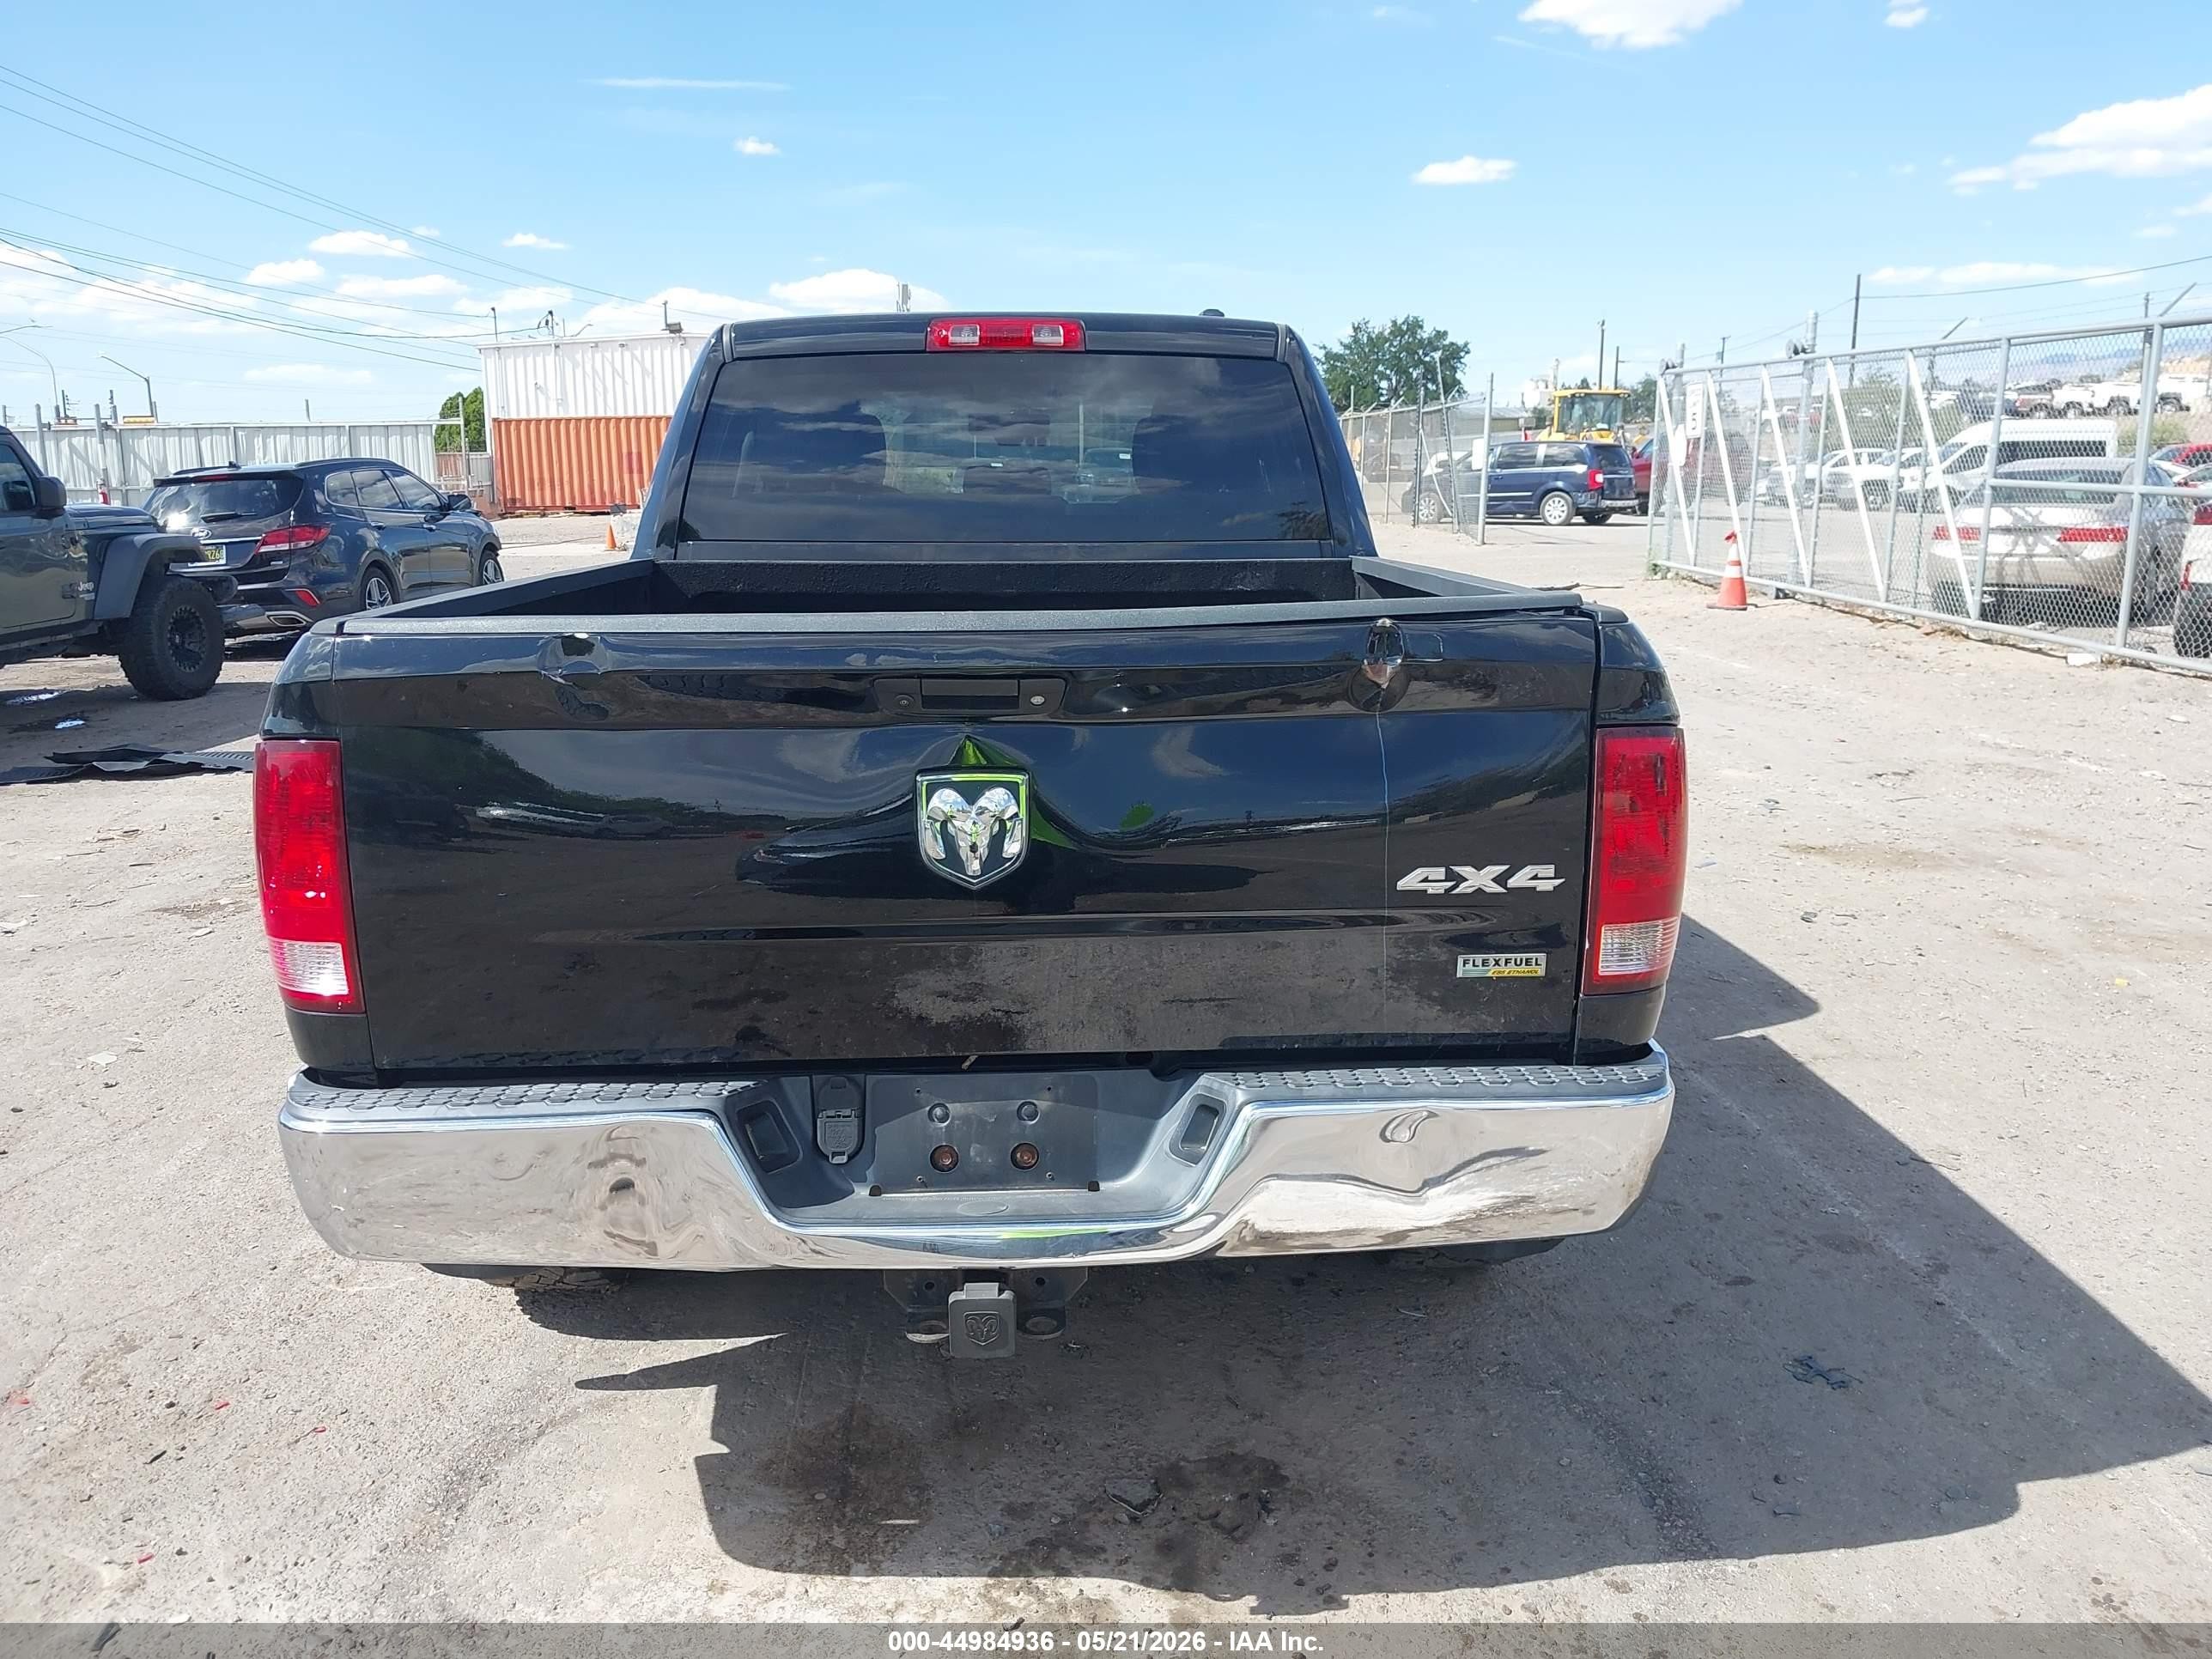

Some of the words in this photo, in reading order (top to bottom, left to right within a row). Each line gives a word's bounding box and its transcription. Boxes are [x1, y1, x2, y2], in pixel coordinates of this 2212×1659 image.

[1691, 412, 1698, 430] 5
[78, 581, 94, 591] Jeep
[1396, 864, 1566, 895] 4X4
[1462, 957, 1543, 969] FLEXFUEL
